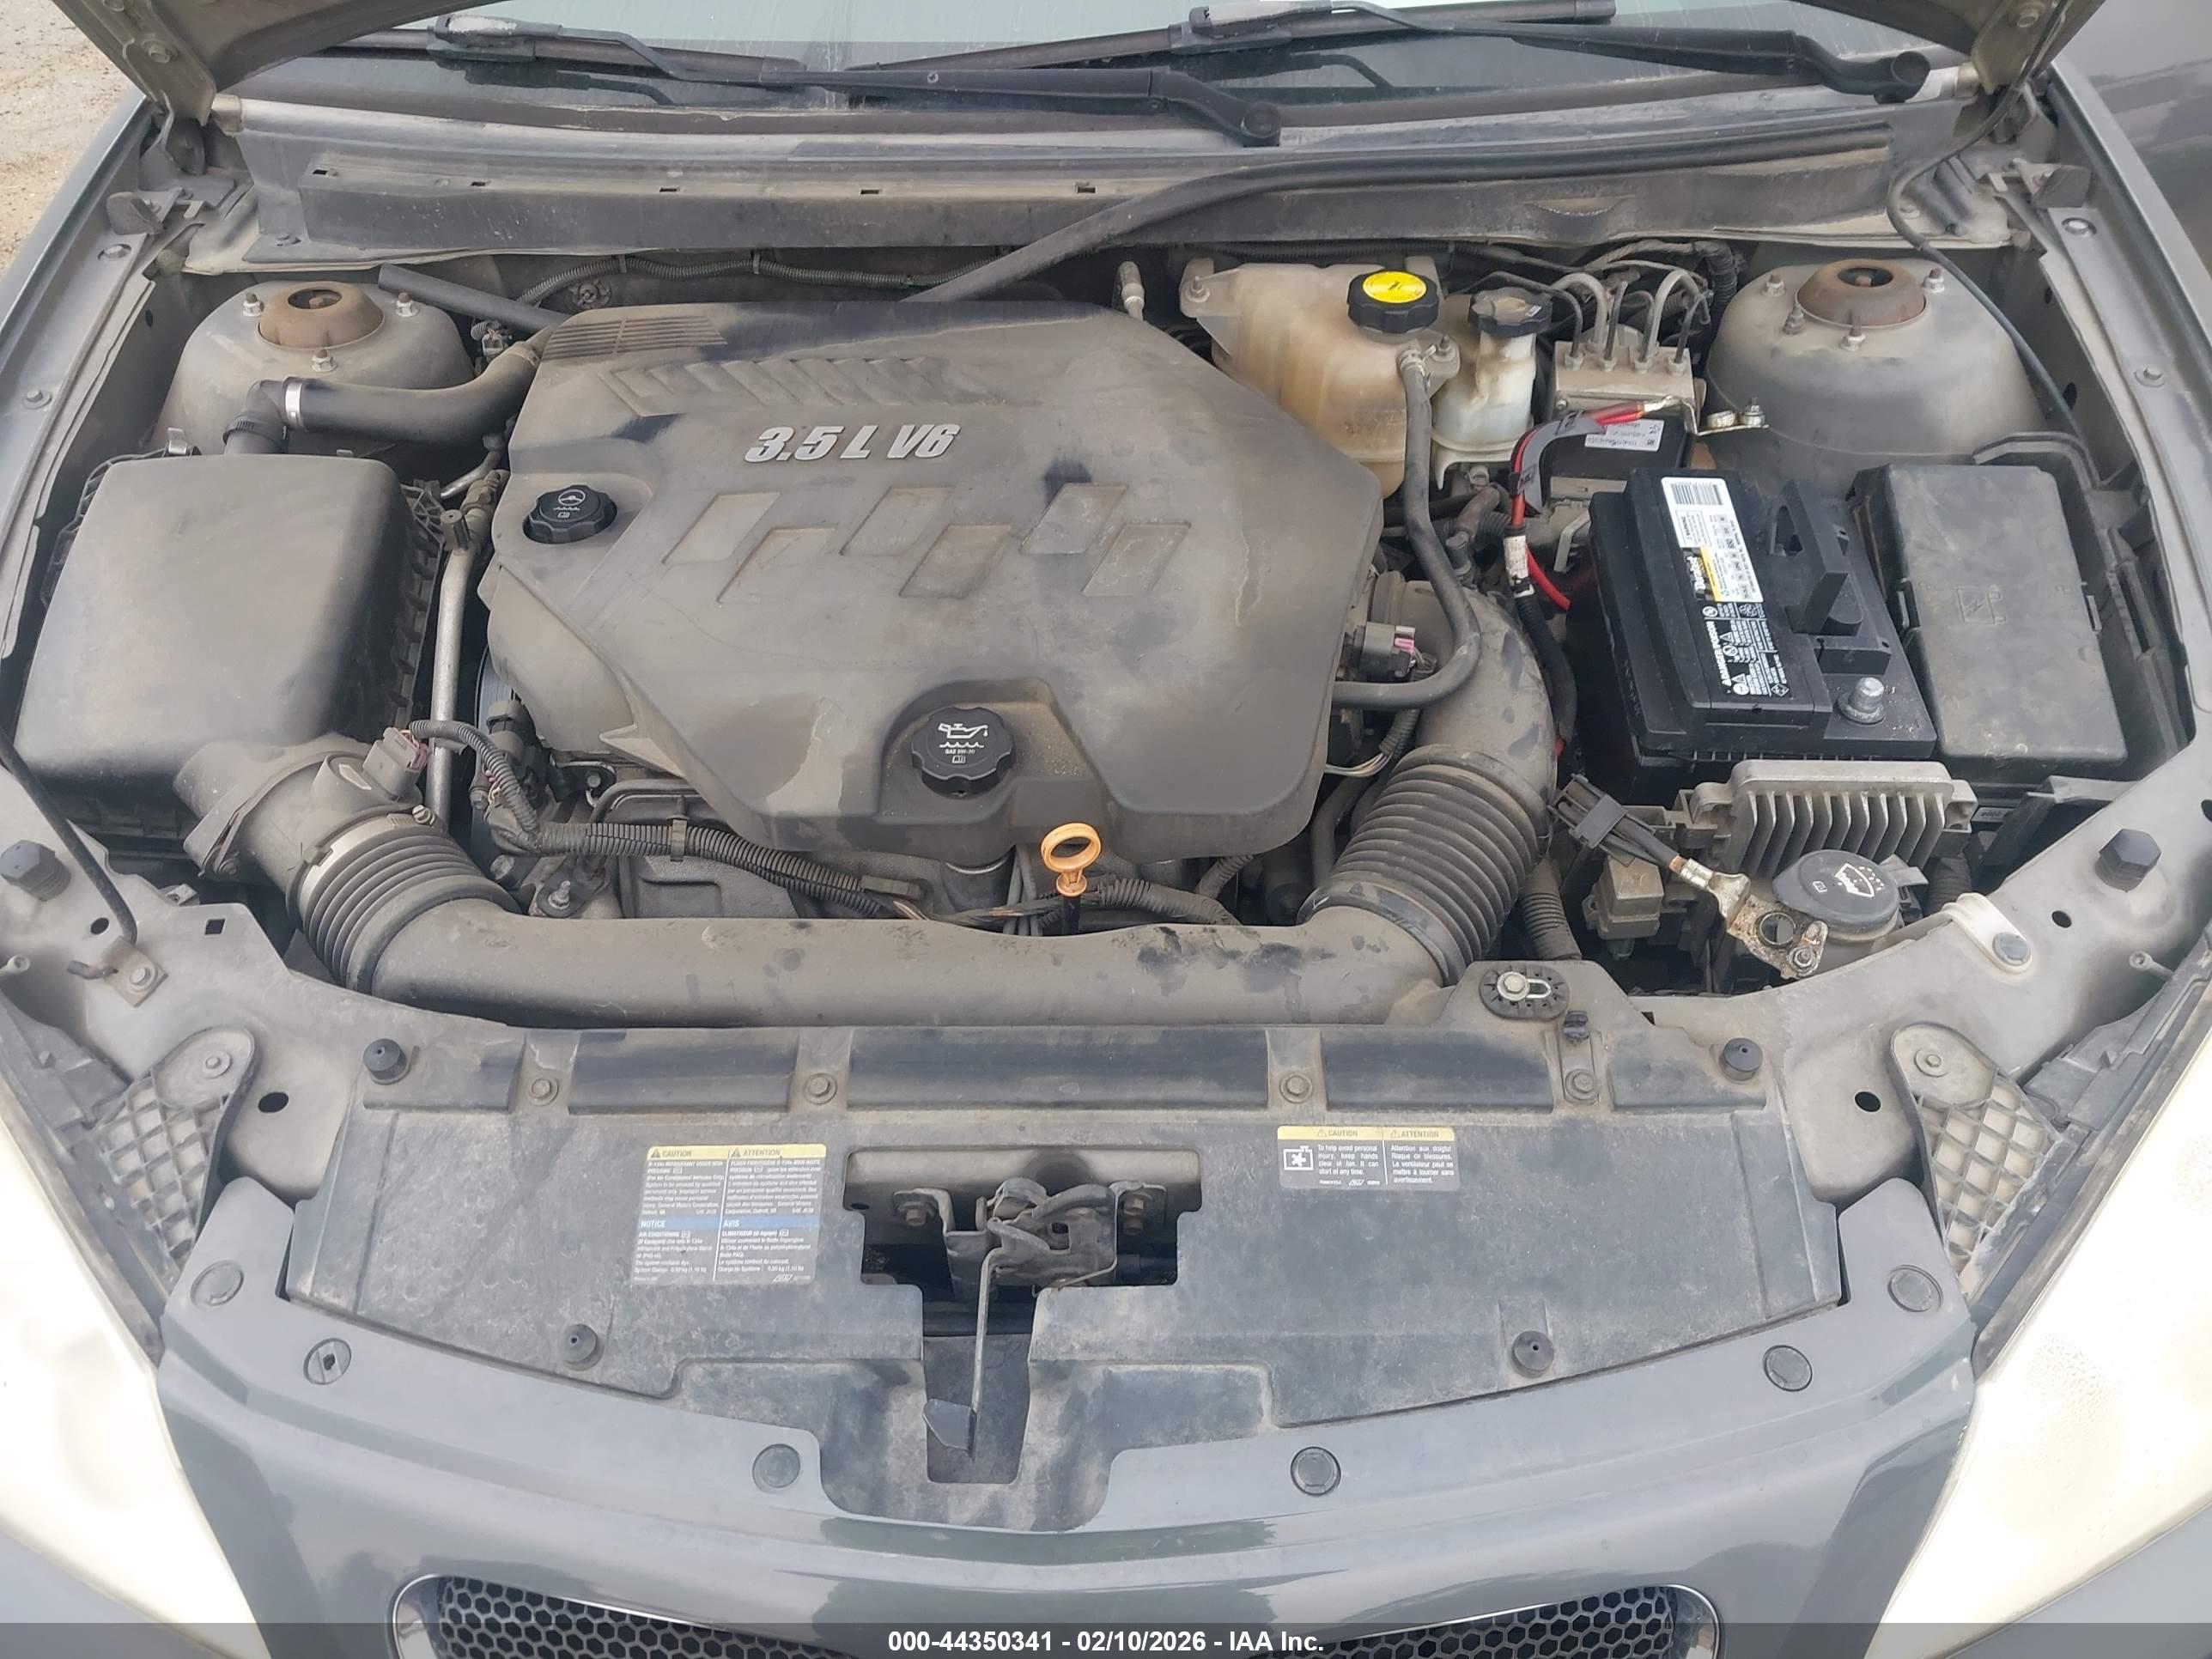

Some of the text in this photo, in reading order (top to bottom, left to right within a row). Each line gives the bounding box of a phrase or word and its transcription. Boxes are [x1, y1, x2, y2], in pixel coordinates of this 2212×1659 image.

[744, 424, 961, 463] 3.5 L V6
[640, 1219, 666, 1228] NOTICE
[723, 1219, 739, 1228] AVIS
